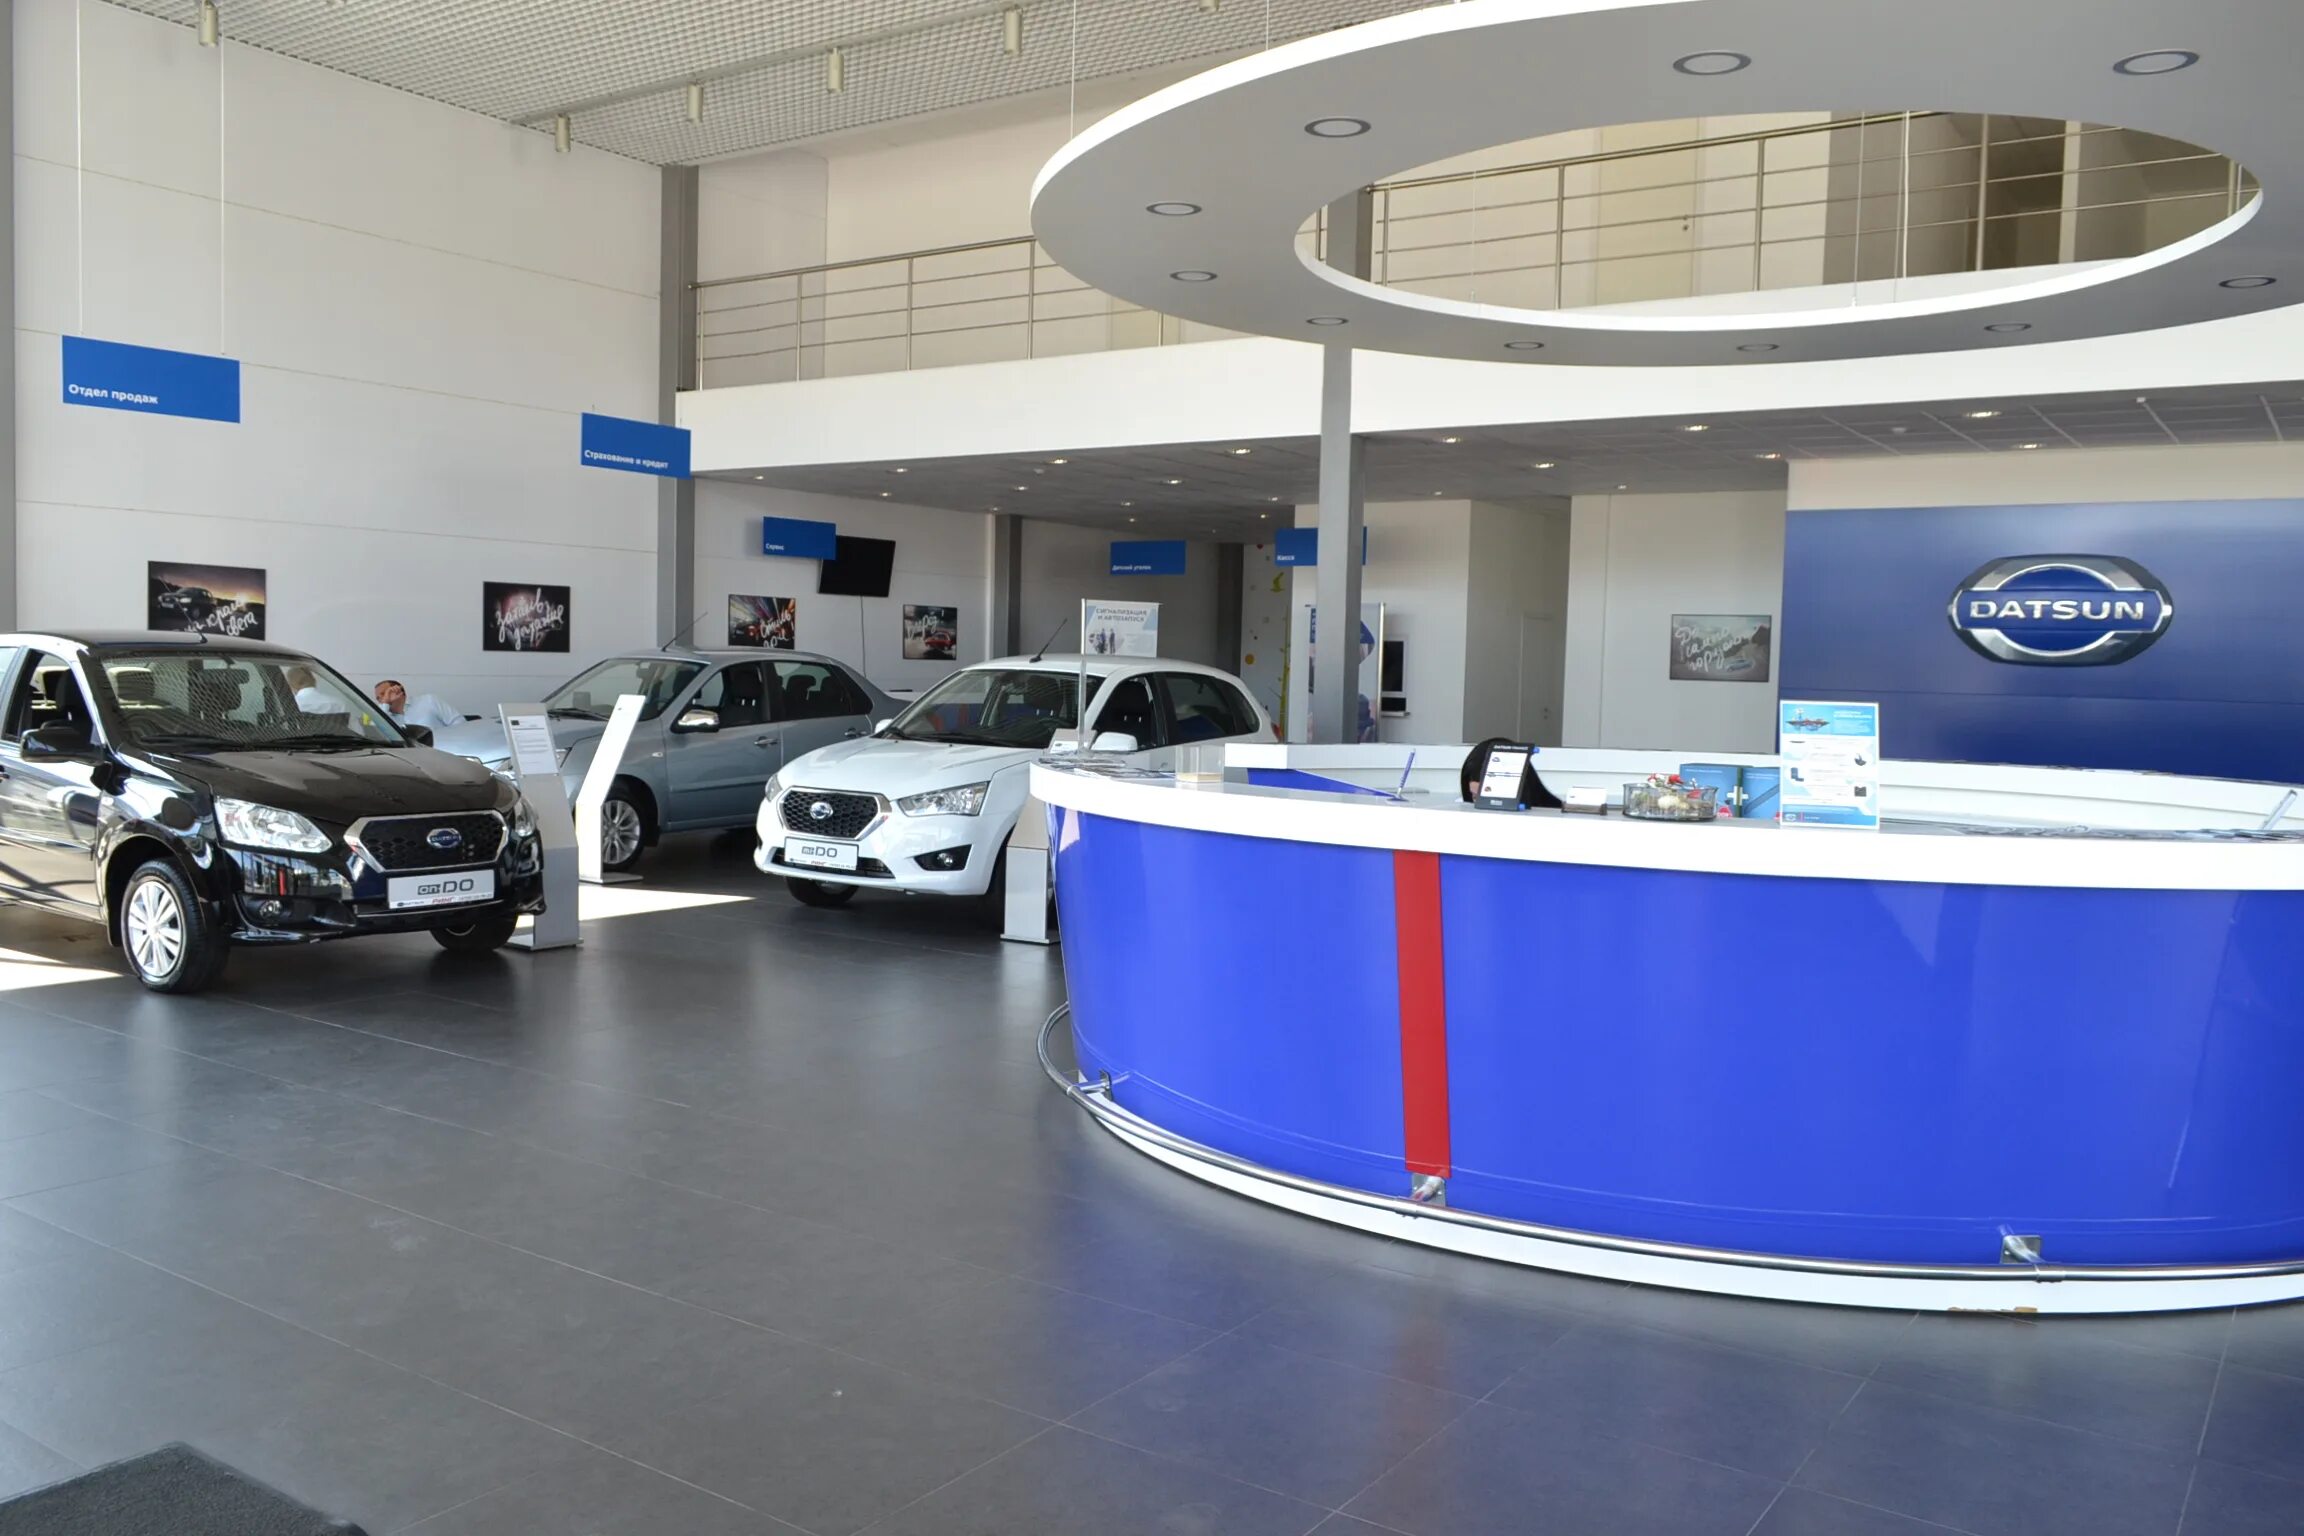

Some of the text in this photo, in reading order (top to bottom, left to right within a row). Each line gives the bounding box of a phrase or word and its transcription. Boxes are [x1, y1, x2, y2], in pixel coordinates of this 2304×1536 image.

[68, 384, 159, 404] Отдел продаж
[584, 449, 634, 464] Страхование
[642, 459, 669, 469] кредит
[1096, 607, 1147, 616] СИГНАЛИЗАЦИЯ
[1969, 600, 2144, 620] DATSUN
